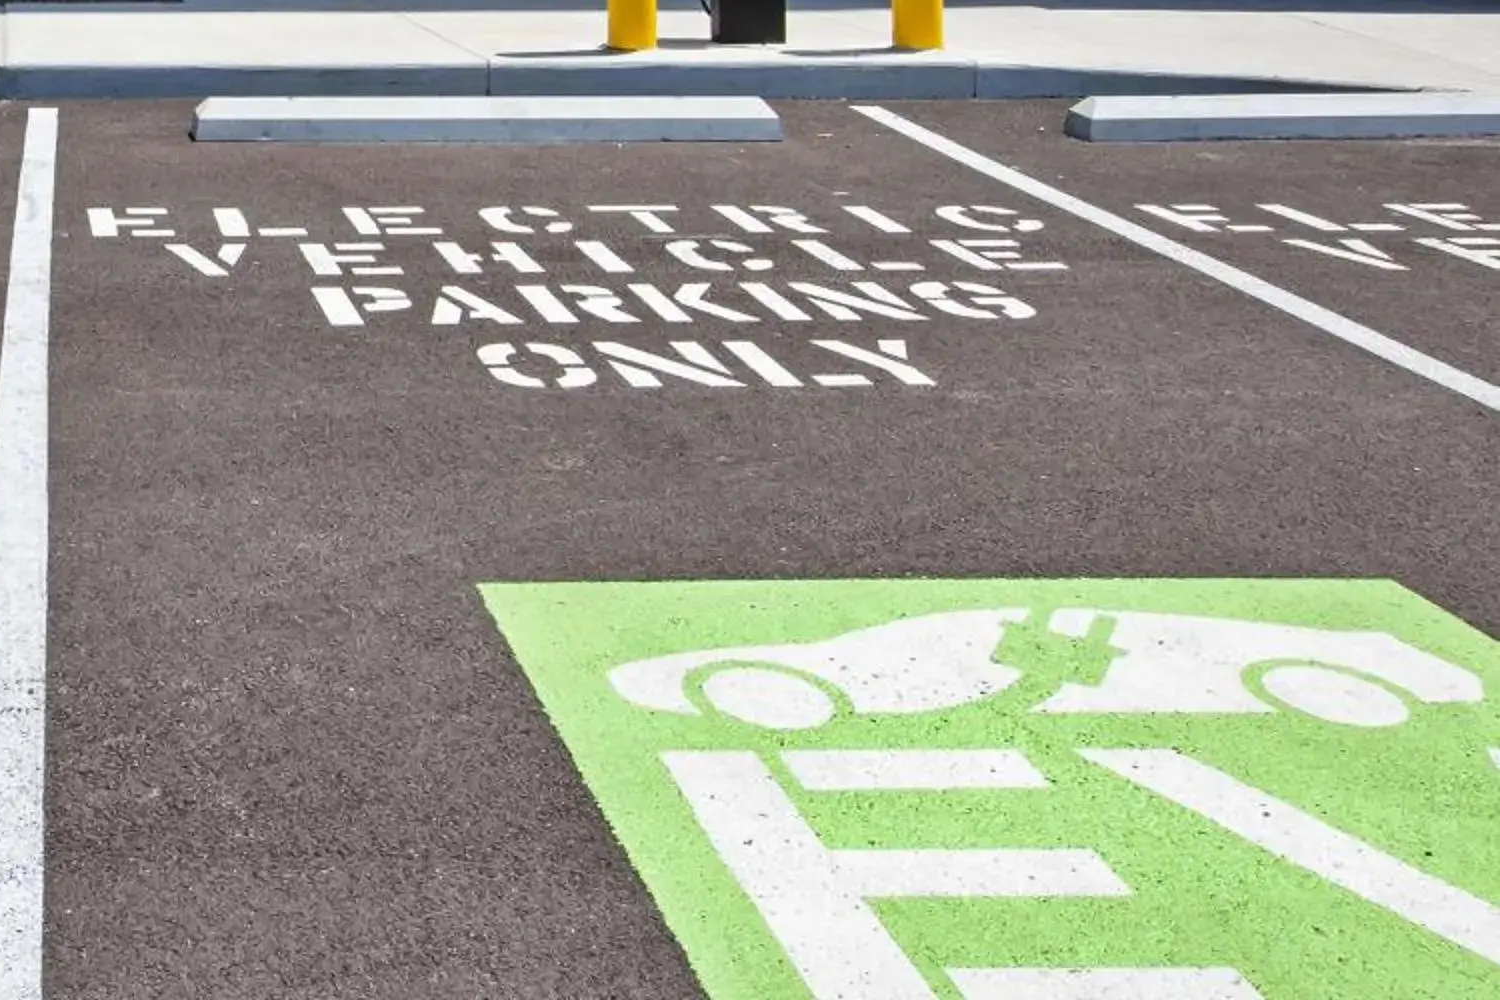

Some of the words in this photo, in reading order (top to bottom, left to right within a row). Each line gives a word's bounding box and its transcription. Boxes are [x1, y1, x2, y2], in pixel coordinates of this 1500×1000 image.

[86, 206, 1044, 237] ELECTRIC
[164, 240, 1069, 276] VEHICLE
[311, 281, 1037, 326] PARKING
[476, 340, 938, 388] ONLY
